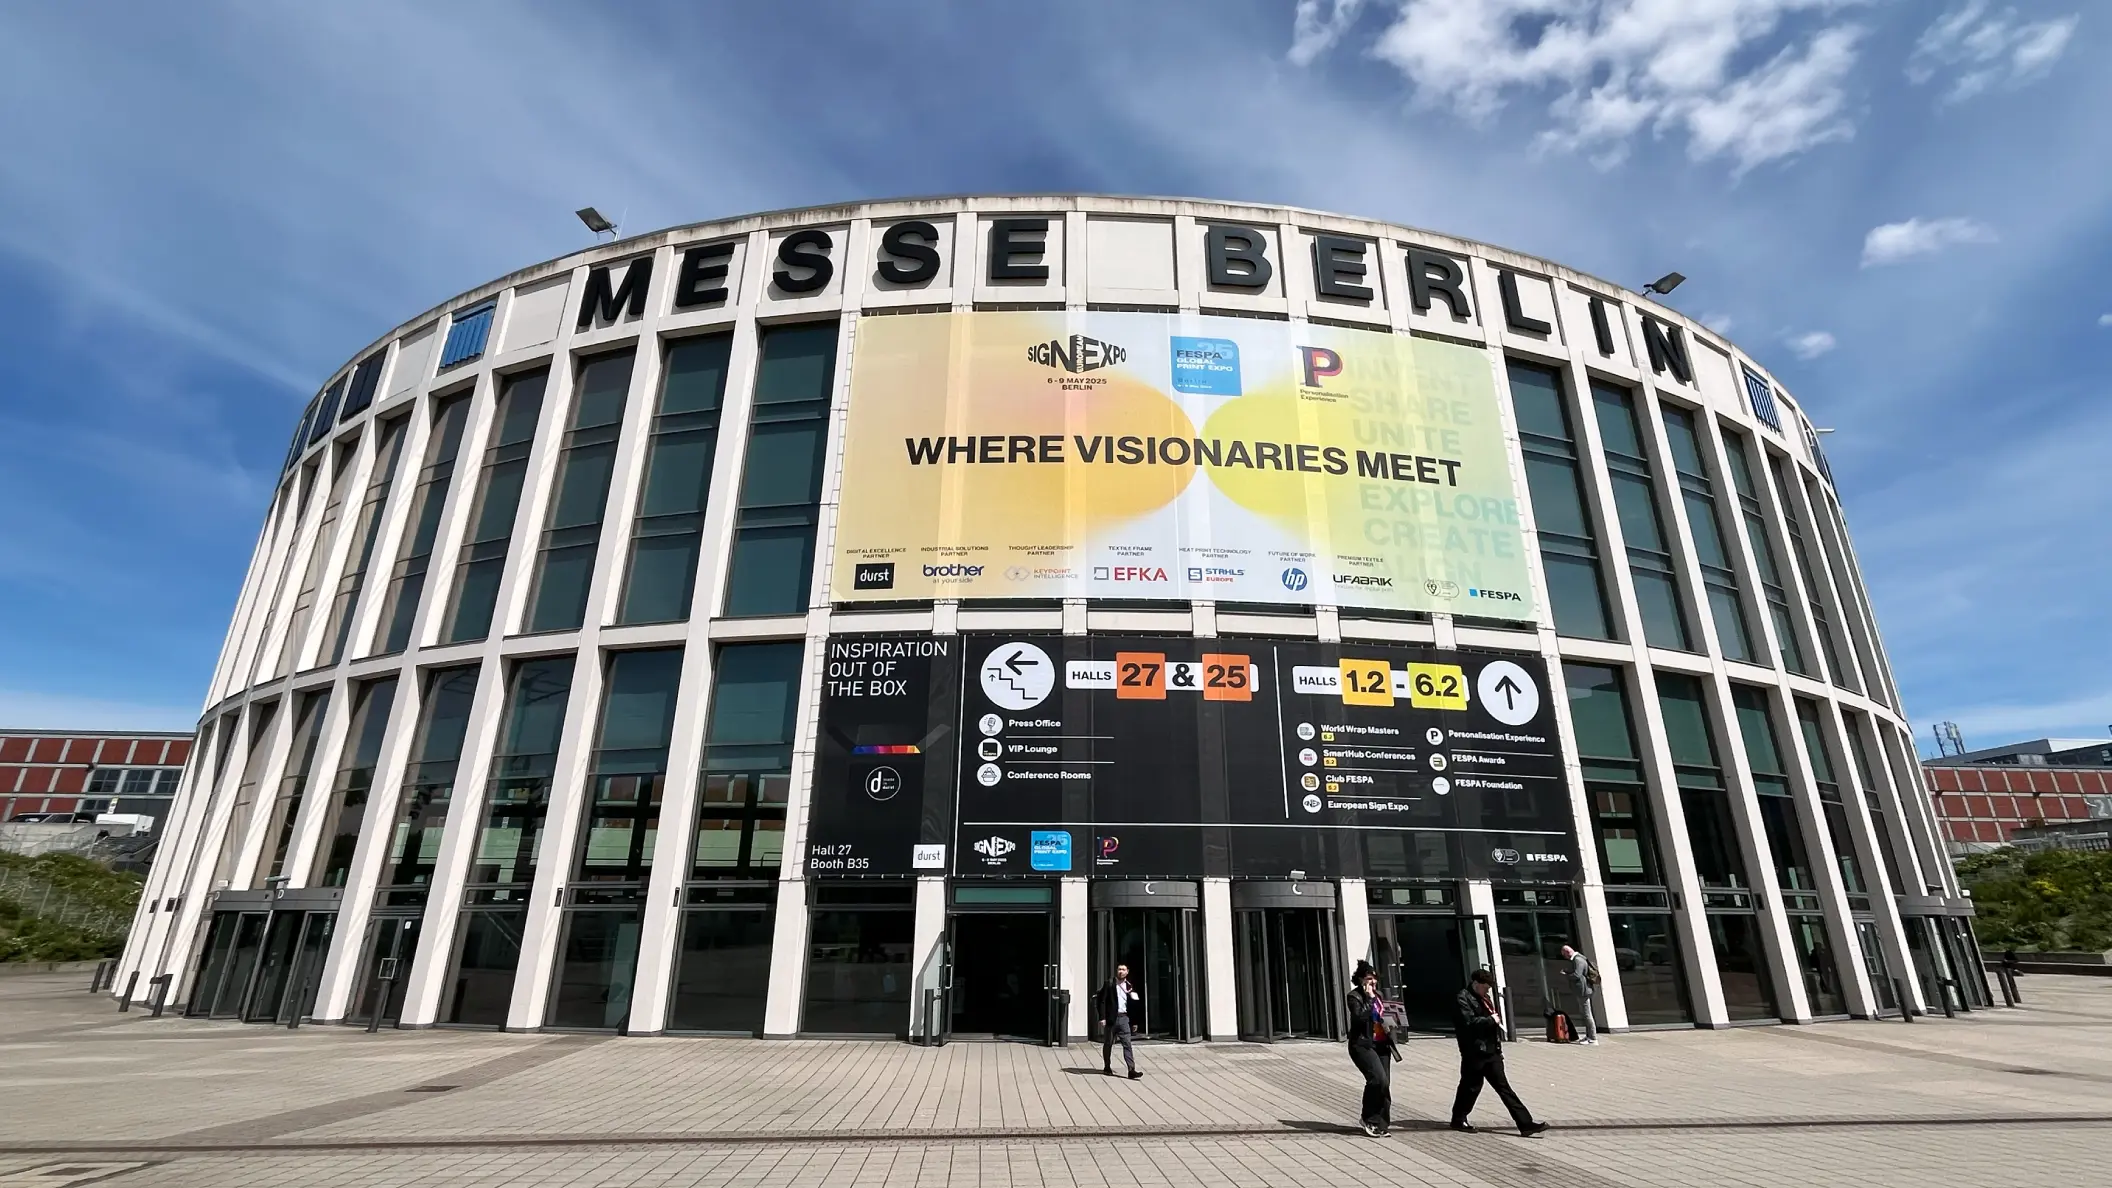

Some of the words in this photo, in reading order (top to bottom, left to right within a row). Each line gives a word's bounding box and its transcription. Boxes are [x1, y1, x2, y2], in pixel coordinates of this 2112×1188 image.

[577, 218, 1050, 328] MESSE
[1206, 225, 1693, 382] BERLIN
[1176, 350, 1223, 359] FESPA
[1350, 388, 1473, 426] SHARE
[1352, 419, 1463, 457] UNITE
[905, 436, 1065, 465] WHERE
[1073, 434, 1349, 476] VISIONARIES
[1356, 450, 1461, 486] MEET
[1359, 483, 1520, 526] EXPLORE
[1363, 519, 1515, 558] CREATE
[859, 568, 890, 582] durst
[923, 563, 985, 577] brother
[1114, 567, 1168, 582] EFKA
[1285, 568, 1305, 591] hp
[1333, 574, 1393, 587] UFABRIK
[1479, 589, 1522, 602] FESPA
[830, 641, 948, 658] INSPIRATION
[829, 662, 867, 677] OUT
[872, 661, 896, 677] OF
[1072, 670, 1112, 681] HALLS
[1121, 662, 1160, 687] 27
[1171, 663, 1196, 687] &
[1207, 665, 1247, 688] 25
[828, 681, 864, 696] THE
[870, 680, 907, 696] BOX
[1299, 675, 1337, 687] HALLS
[1346, 669, 1386, 694] 1.2
[1415, 673, 1459, 698] 6.2
[1008, 719, 1034, 727] Press
[1034, 719, 1061, 728] Office
[1321, 724, 1345, 733] World
[1346, 725, 1367, 734] Wrap
[1367, 726, 1400, 735] Masters
[1448, 730, 1504, 740] Personalisation
[1505, 733, 1546, 743] Experience
[1008, 745, 1024, 753] VIP
[1024, 745, 1058, 754] Lounge
[1323, 749, 1365, 758] SmartHub
[1365, 750, 1416, 760] Conferences
[1451, 754, 1478, 763] FESPA
[1479, 755, 1506, 764] Awards
[1007, 771, 1059, 779] Conference
[1060, 771, 1092, 779] Rooms
[1325, 774, 1345, 783] Club
[1346, 775, 1374, 784] FESPA
[1455, 779, 1481, 788] FESPA
[1482, 780, 1523, 790] Foundation
[1327, 800, 1367, 810] European
[1368, 802, 1387, 811] Sign
[1388, 802, 1409, 811] Expo
[812, 845, 835, 855] Hall
[838, 845, 852, 855] 27
[917, 850, 941, 861] durst
[810, 857, 844, 869] Booth
[846, 857, 870, 869] B35
[1535, 853, 1569, 863] FESPA
